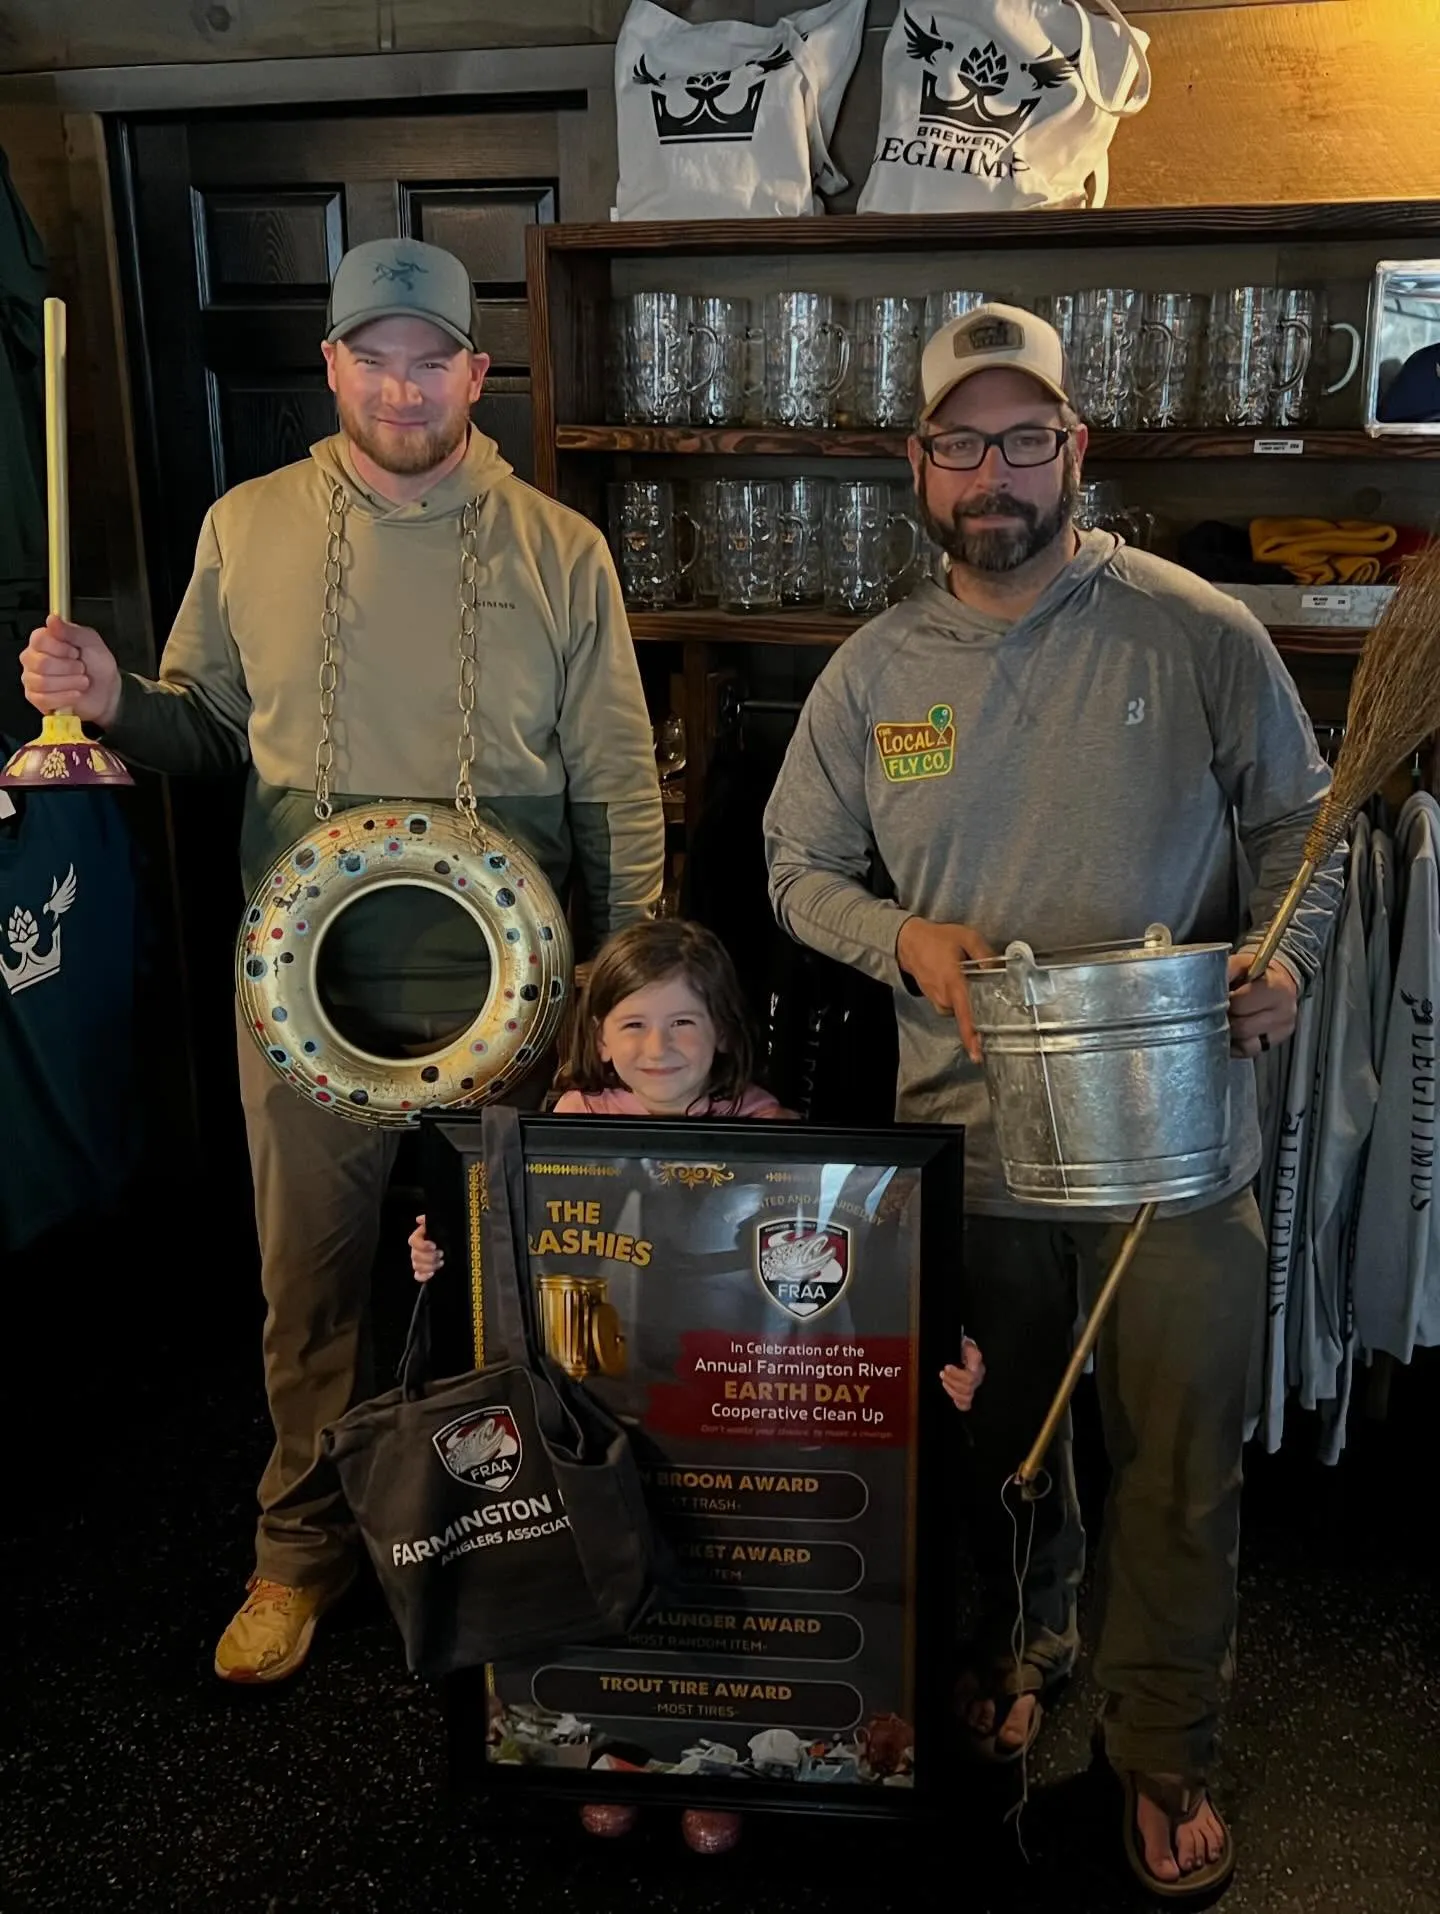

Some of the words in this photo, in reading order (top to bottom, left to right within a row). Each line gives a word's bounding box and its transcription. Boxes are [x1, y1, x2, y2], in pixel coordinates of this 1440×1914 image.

[916, 126, 1003, 154] BREWERY
[874, 137, 1031, 179] EGITIM
[882, 730, 935, 754] LOCAL
[889, 757, 919, 776] FLY
[923, 752, 948, 772] CO.
[546, 1200, 601, 1225] THE
[778, 1284, 827, 1299] FRAA
[730, 1341, 743, 1354] In
[747, 1342, 822, 1357] Celebration
[825, 1344, 840, 1357] of
[842, 1345, 865, 1358] the
[694, 1358, 752, 1373] Annual
[757, 1360, 853, 1379] Farmington
[858, 1363, 902, 1378] River
[724, 1380, 807, 1402] EARTH
[814, 1383, 871, 1404] DAY
[711, 1403, 809, 1421] Cooperative
[812, 1406, 857, 1421] Clean
[862, 1408, 885, 1424] Up
[470, 1458, 513, 1481] FRAA
[656, 1471, 733, 1490] BROOM
[738, 1476, 819, 1493] AWARD
[392, 1493, 553, 1567] FARMINGTON
[441, 1531, 503, 1567] ANGLERS
[506, 1515, 571, 1542] ASSOCIAT
[731, 1545, 812, 1564] AWARD
[742, 1615, 822, 1634] AWARD
[599, 1675, 663, 1694] TROUT
[668, 1679, 709, 1696] TIRE
[714, 1682, 793, 1700] AWARD
